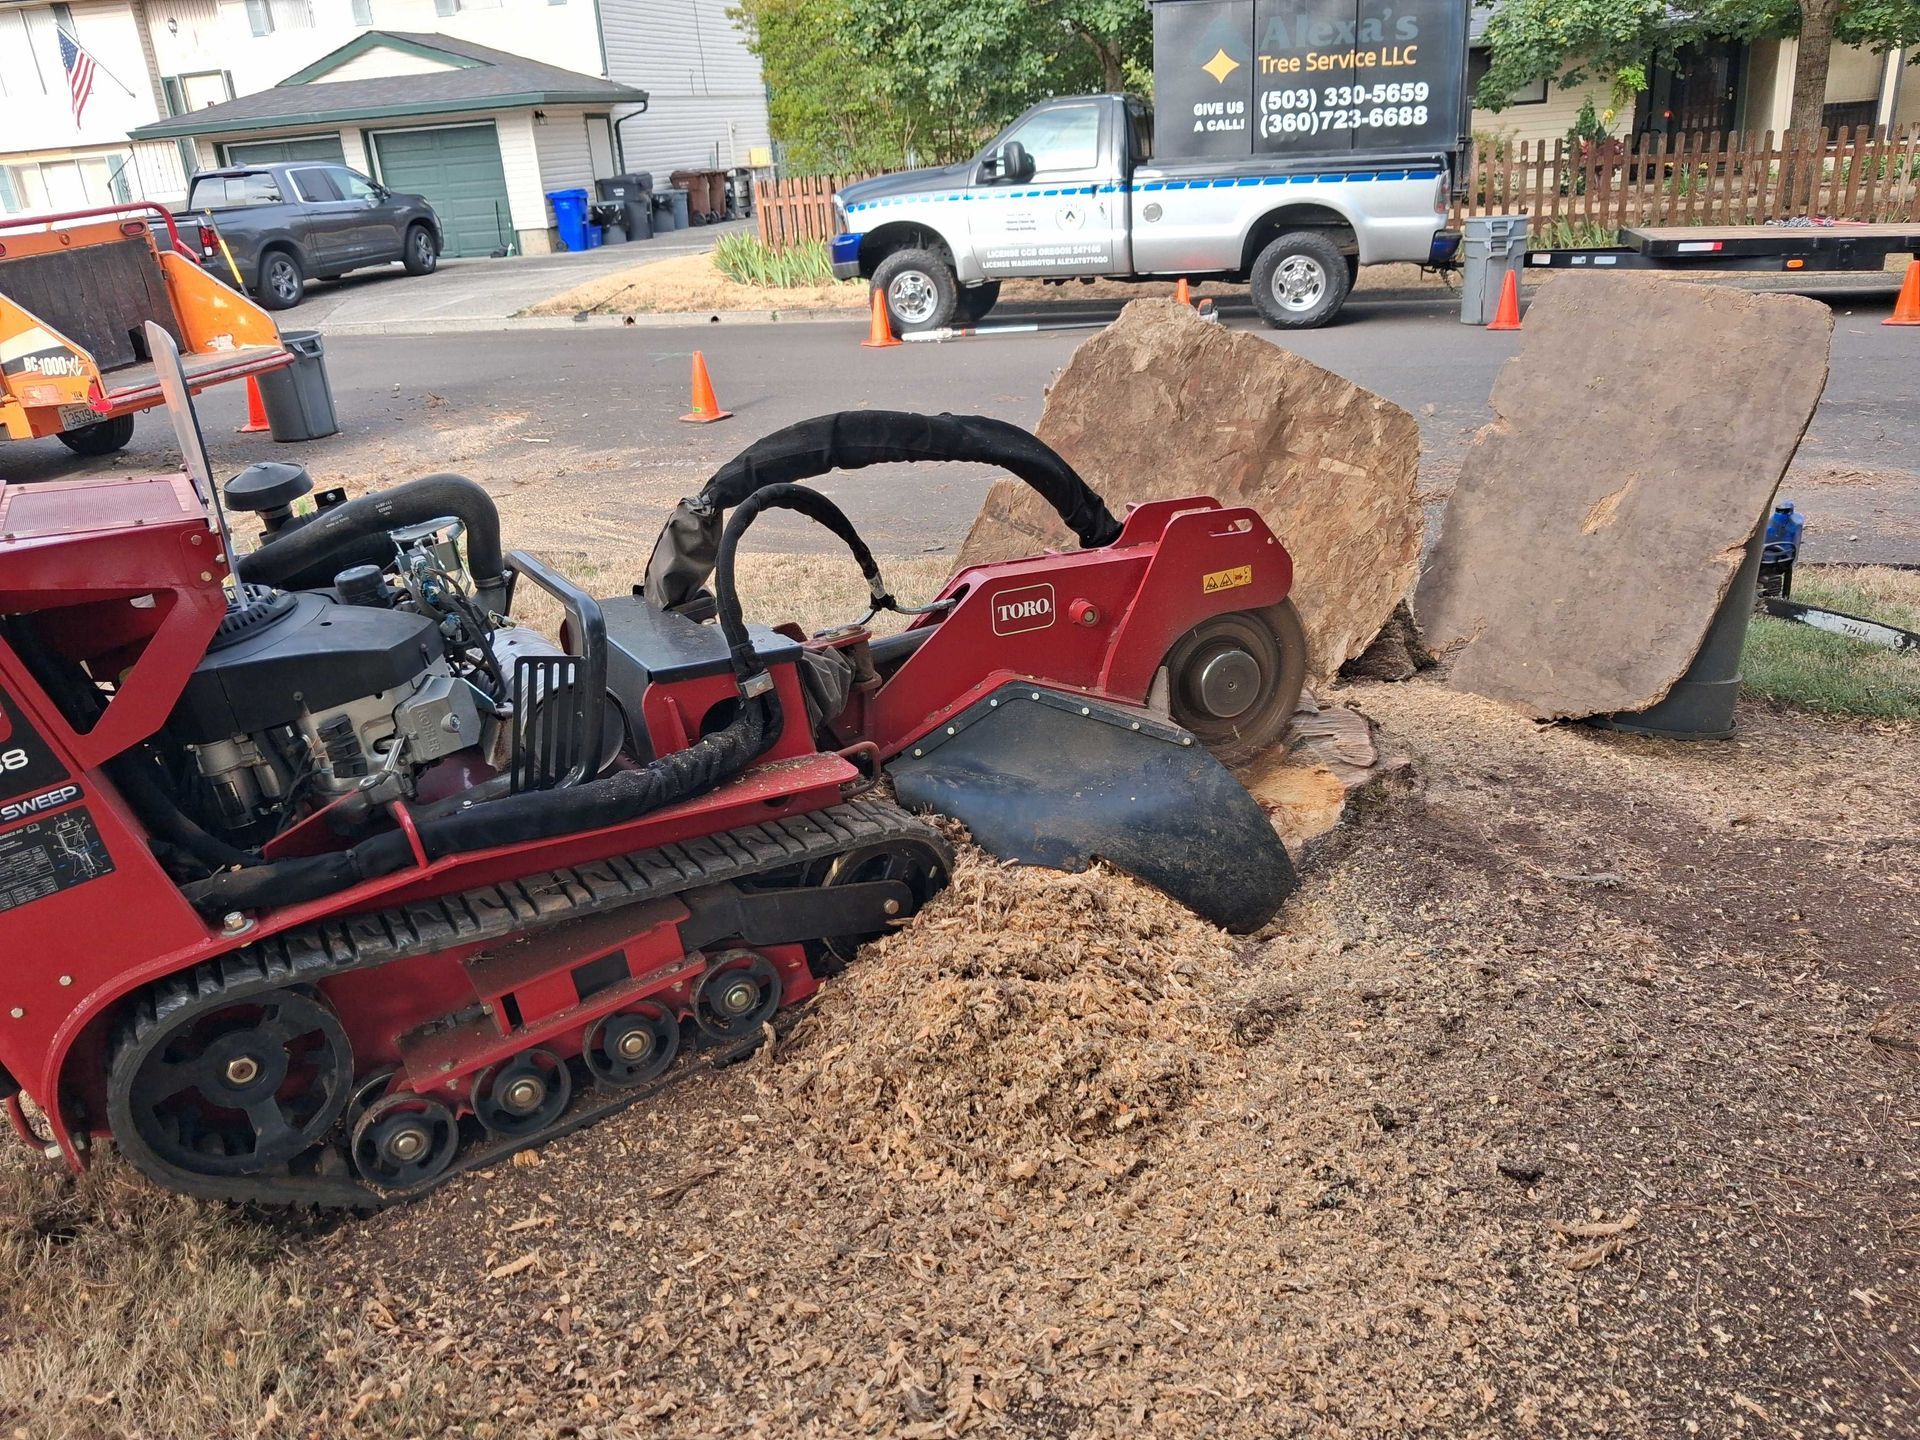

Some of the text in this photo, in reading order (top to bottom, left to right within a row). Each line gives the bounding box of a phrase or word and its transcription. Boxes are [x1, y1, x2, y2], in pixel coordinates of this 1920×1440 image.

[1261, 8, 1419, 50] Alexa's
[1258, 45, 1418, 75] Tree Service LLC
[1193, 101, 1244, 116] GIVE US
[1260, 82, 1429, 114] (503) 330-5659
[1193, 118, 1245, 132] A CALL!
[1260, 105, 1429, 138] (360)723-6688
[982, 260, 1010, 268] LICENSE
[1010, 258, 1056, 267] WASHINGTON
[986, 249, 1019, 258] LICENSE
[1038, 246, 1072, 256] OREGON
[997, 598, 1050, 622] TORO
[416, 706, 441, 755] KOHLER
[0, 748, 29, 774] 8
